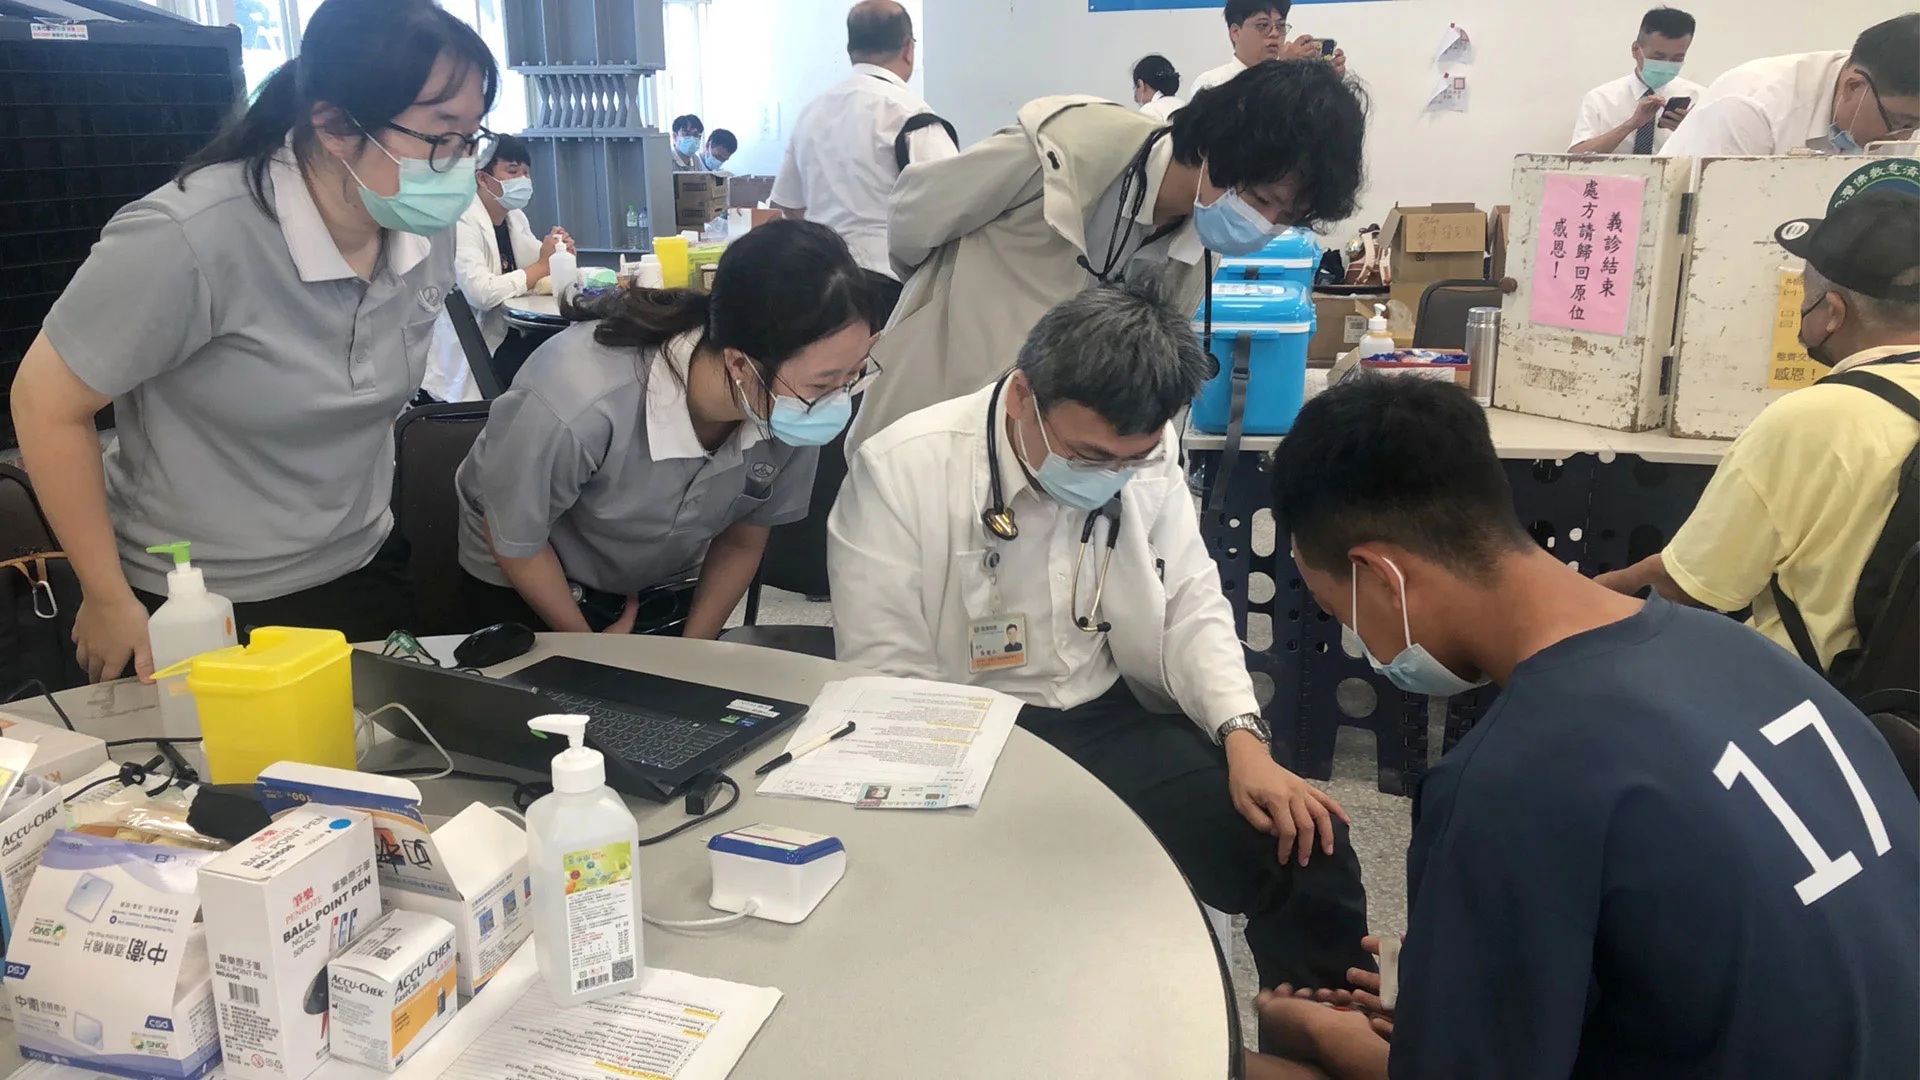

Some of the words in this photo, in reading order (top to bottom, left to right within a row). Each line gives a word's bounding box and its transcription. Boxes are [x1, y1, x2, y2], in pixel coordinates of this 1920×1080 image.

[1550, 217, 1568, 279] 感恩！
[1568, 179, 1600, 321] 處方請歸回原位
[1599, 211, 1623, 298] 義診結束
[1, 805, 58, 850] ACCU-CHEK
[1712, 699, 1893, 906] 17
[283, 918, 313, 944] BALL
[315, 891, 349, 921] POINT
[351, 875, 371, 896] PEN
[330, 974, 384, 998] ACCU-CHEK
[394, 938, 451, 996] ACCU-CHEK
